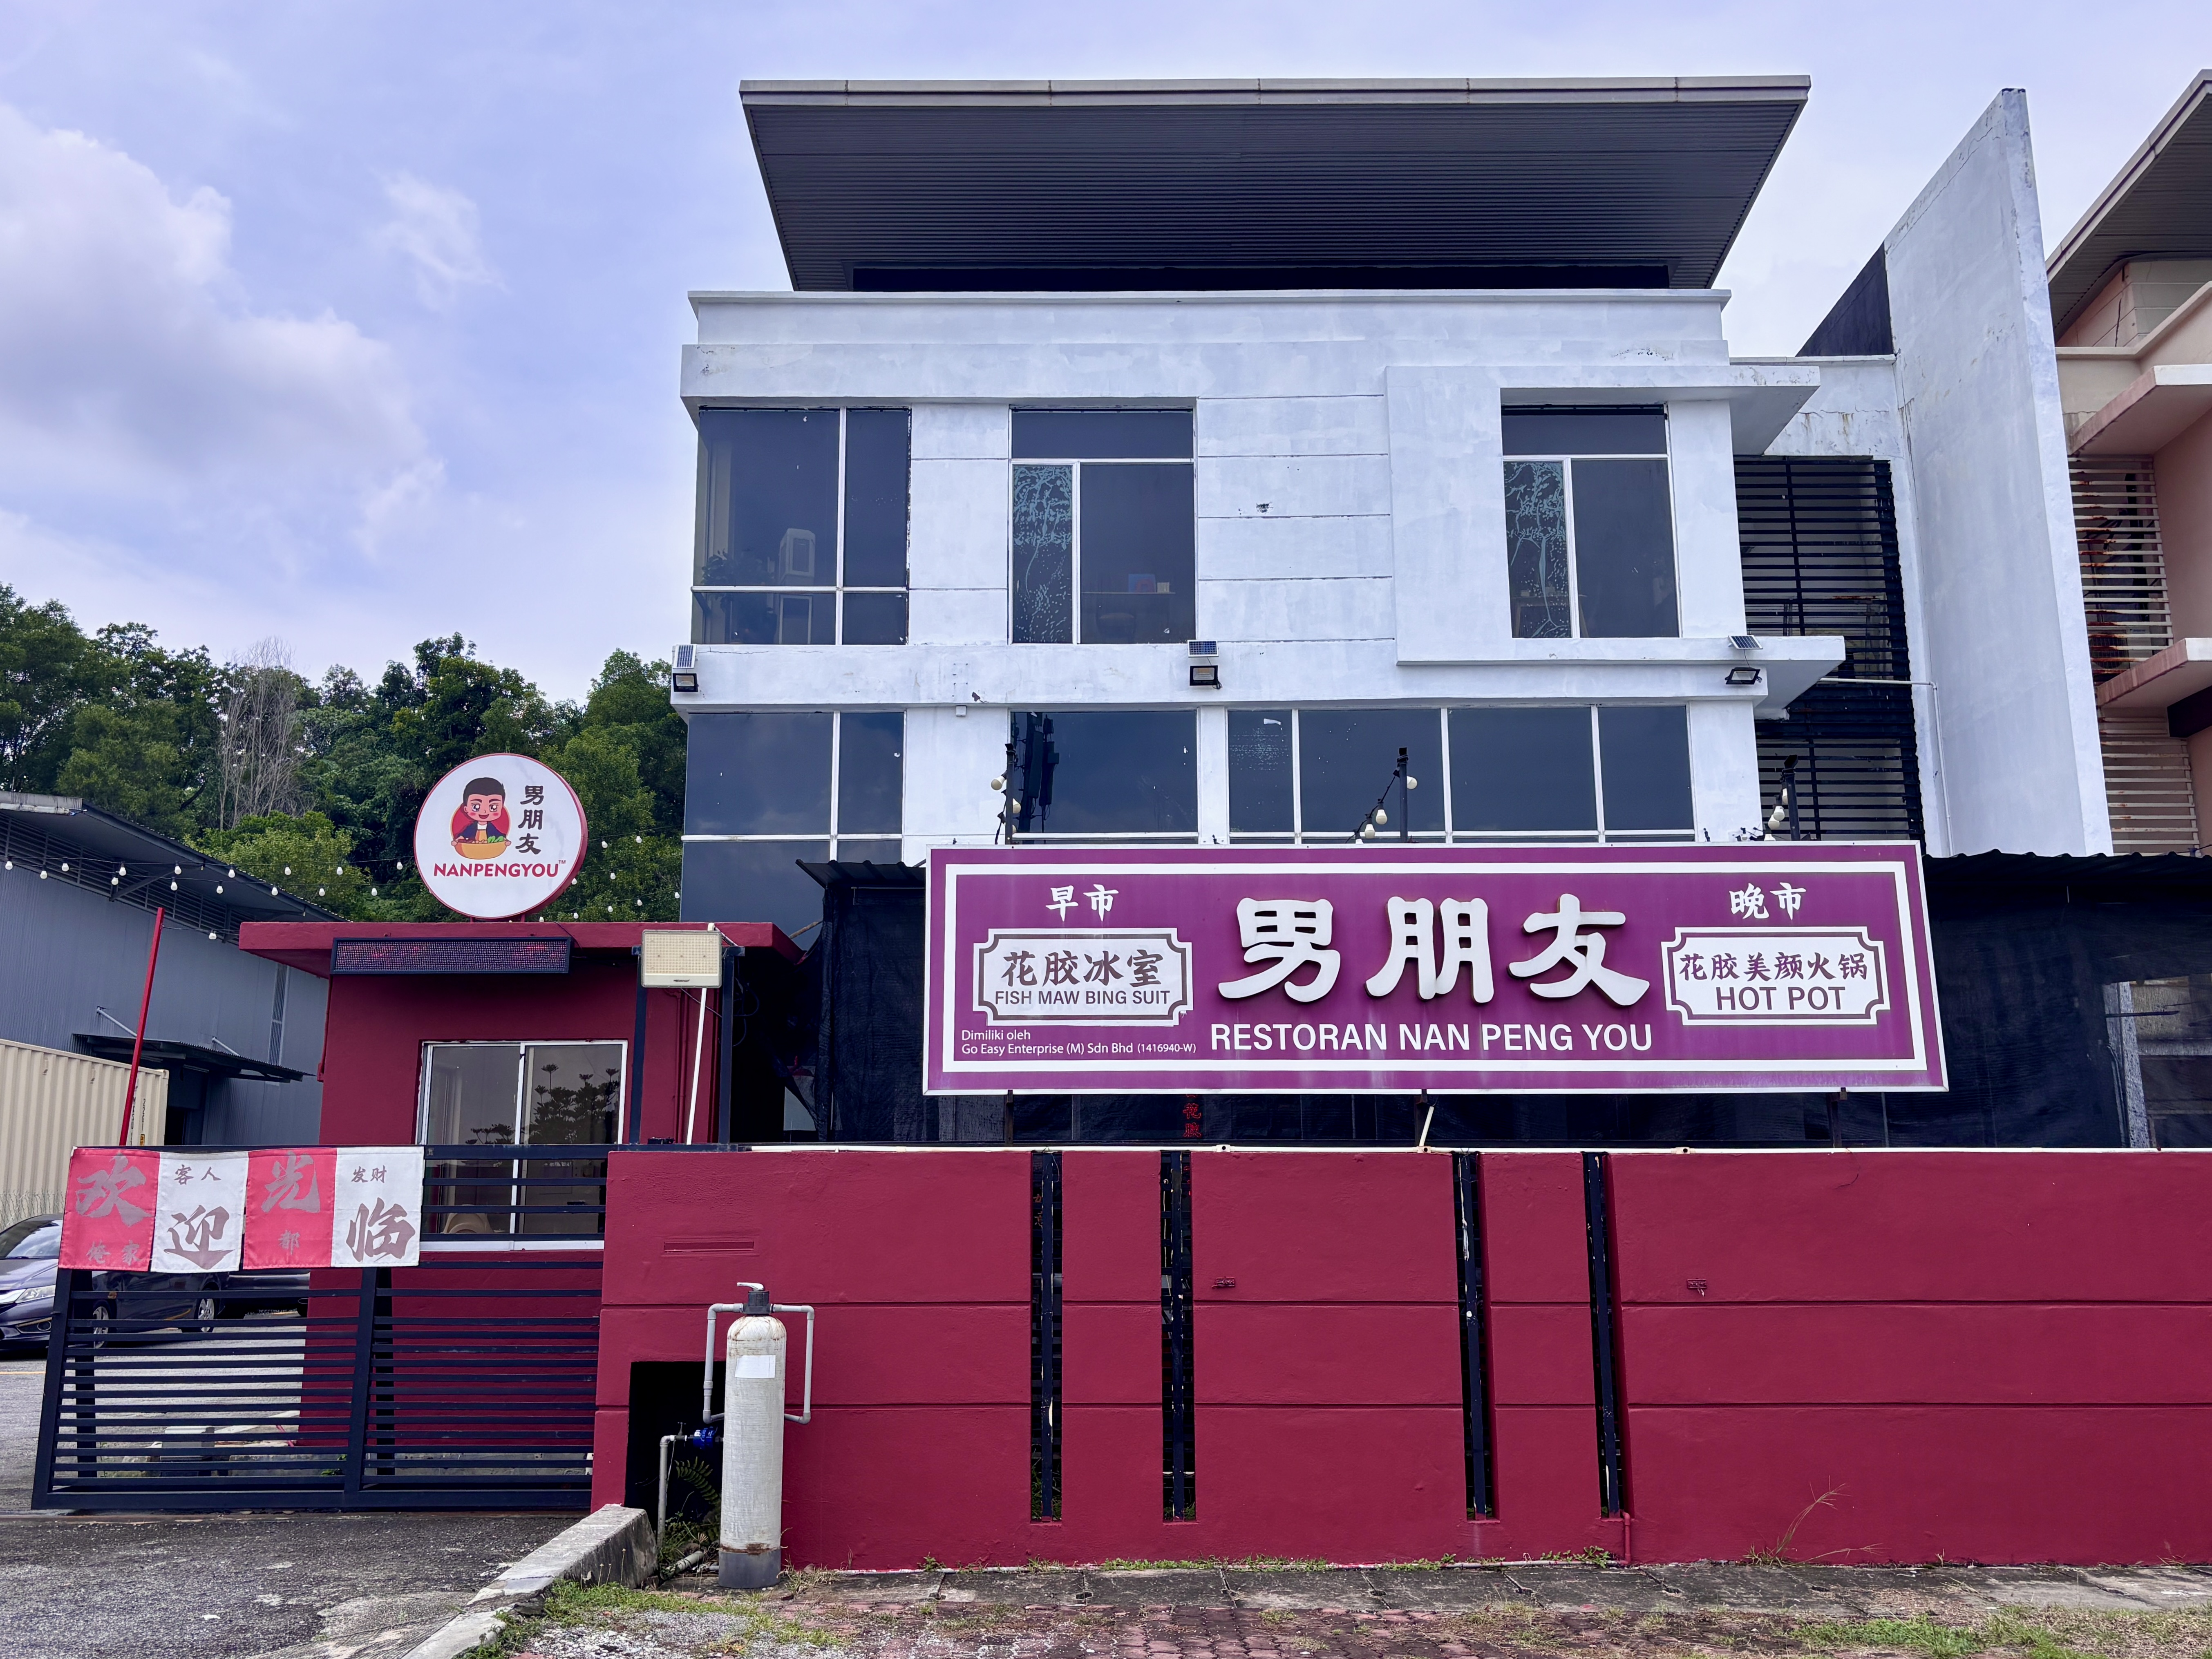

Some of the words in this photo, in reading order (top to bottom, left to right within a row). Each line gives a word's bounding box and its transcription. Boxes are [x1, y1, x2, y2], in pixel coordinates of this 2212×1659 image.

[515, 785, 544, 855] 男朋友
[434, 863, 559, 877] NANPENGYOU
[1045, 884, 1119, 922] 早市
[1729, 882, 1806, 920] 晚市
[1218, 893, 1650, 1006] 男朋友
[1001, 949, 1163, 988] 花胶冰室
[1679, 952, 1868, 982] 花胶美颜火锅
[995, 990, 1032, 1004] FISH
[1038, 990, 1080, 1004] MAW
[1086, 990, 1127, 1004] BING
[1132, 990, 1170, 1004] SUIT
[1716, 986, 1777, 1011] HOT
[1788, 986, 1845, 1010] POT
[962, 1029, 1004, 1041] Dimiliki
[1006, 1029, 1031, 1040] oleh
[962, 1044, 978, 1054] Go
[981, 1044, 1005, 1057] Easy
[1008, 1043, 1064, 1056] Enterprise
[1067, 1043, 1084, 1055] (M)
[1087, 1042, 1108, 1053] Sdn
[1112, 1042, 1133, 1053] Bhd
[1137, 1043, 1197, 1053] (1416940-W)
[1211, 1024, 1387, 1050] RESTORAN
[1399, 1024, 1469, 1050] NAN
[1482, 1024, 1573, 1051] PENG
[1581, 1024, 1652, 1051] YOU
[174, 1164, 221, 1185] 客人
[278, 1230, 300, 1256] 都
[351, 1165, 387, 1183] 发财
